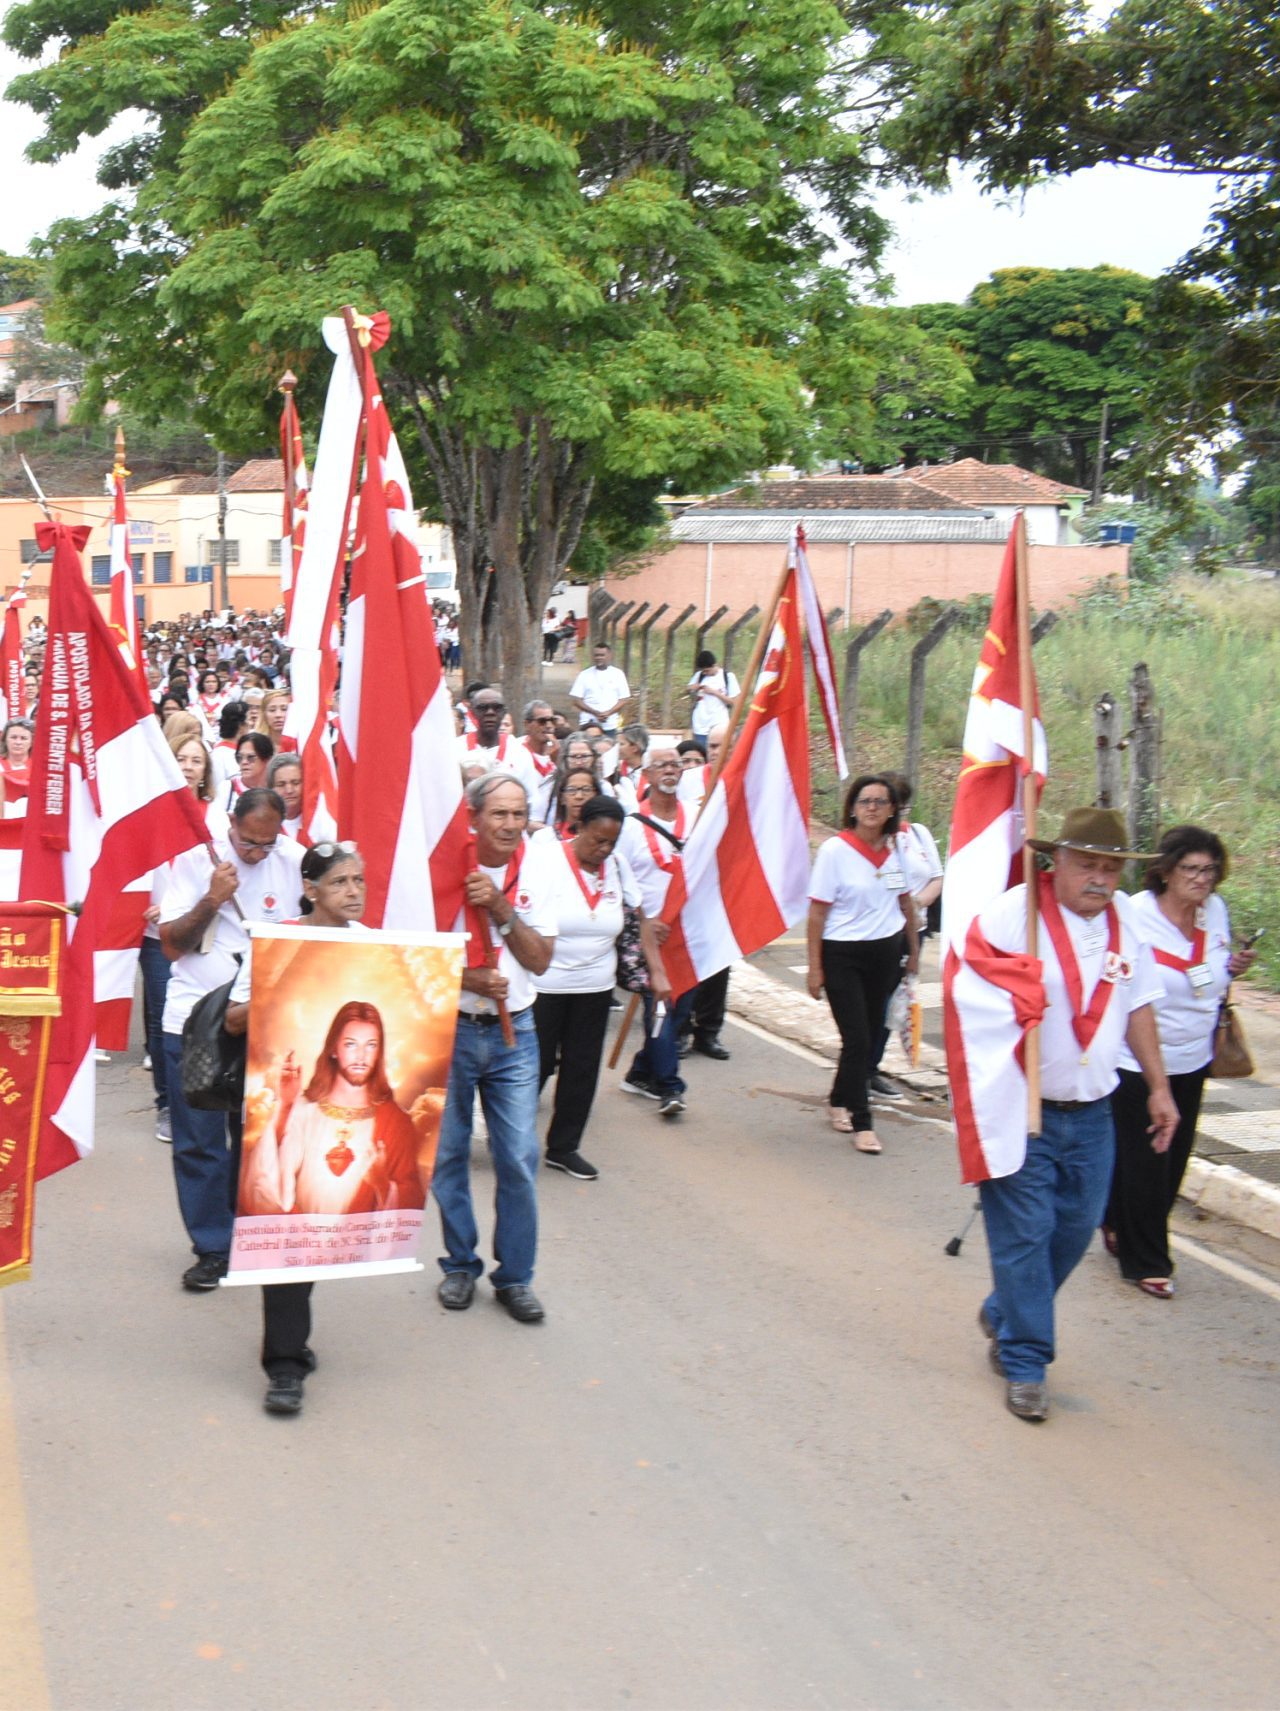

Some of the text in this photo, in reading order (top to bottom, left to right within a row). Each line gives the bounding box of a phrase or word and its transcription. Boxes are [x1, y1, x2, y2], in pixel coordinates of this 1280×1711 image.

[9, 660, 19, 699] APOSTOLADO
[69, 632, 93, 710] APOSTOLADO
[52, 694, 69, 710] DE
[52, 710, 69, 722] S.
[79, 710, 93, 729] DA
[50, 724, 68, 773] VICENTE
[47, 774, 65, 816] FERRER
[0, 949, 51, 969] Jesus
